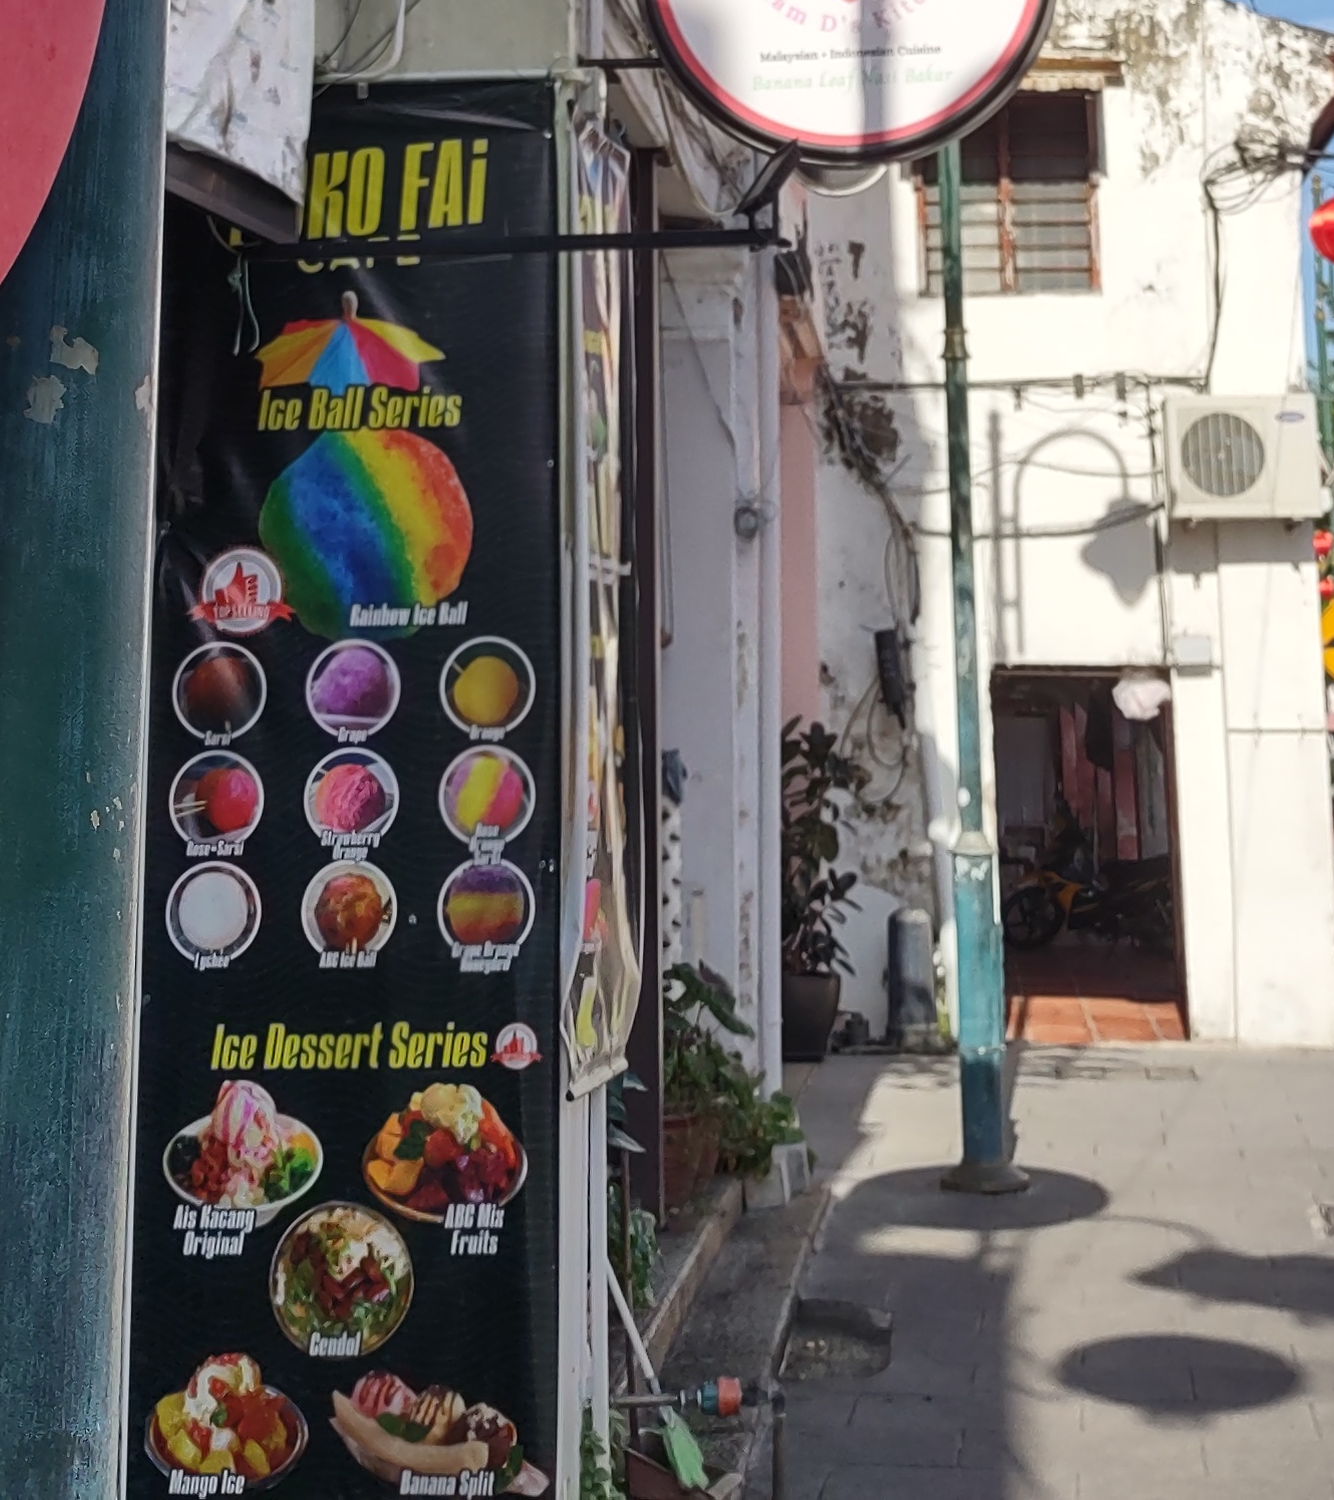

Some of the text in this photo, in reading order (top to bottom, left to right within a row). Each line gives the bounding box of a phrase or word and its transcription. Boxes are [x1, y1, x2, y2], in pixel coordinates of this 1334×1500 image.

[759, 49, 818, 63] Malaysian
[257, 385, 463, 432] Ice Ball Series
[350, 601, 469, 627] Rainbow Ice Ball
[211, 1021, 488, 1070] Ice Dessert Series
[173, 1204, 255, 1233] Ais Kacang
[444, 1203, 506, 1229] ABC Mix
[183, 1229, 245, 1260] Original
[450, 1229, 499, 1256] Fruits
[308, 1329, 362, 1357] Cendol
[168, 1468, 246, 1499] Mango Ice
[399, 1469, 495, 1499] Banana Split
